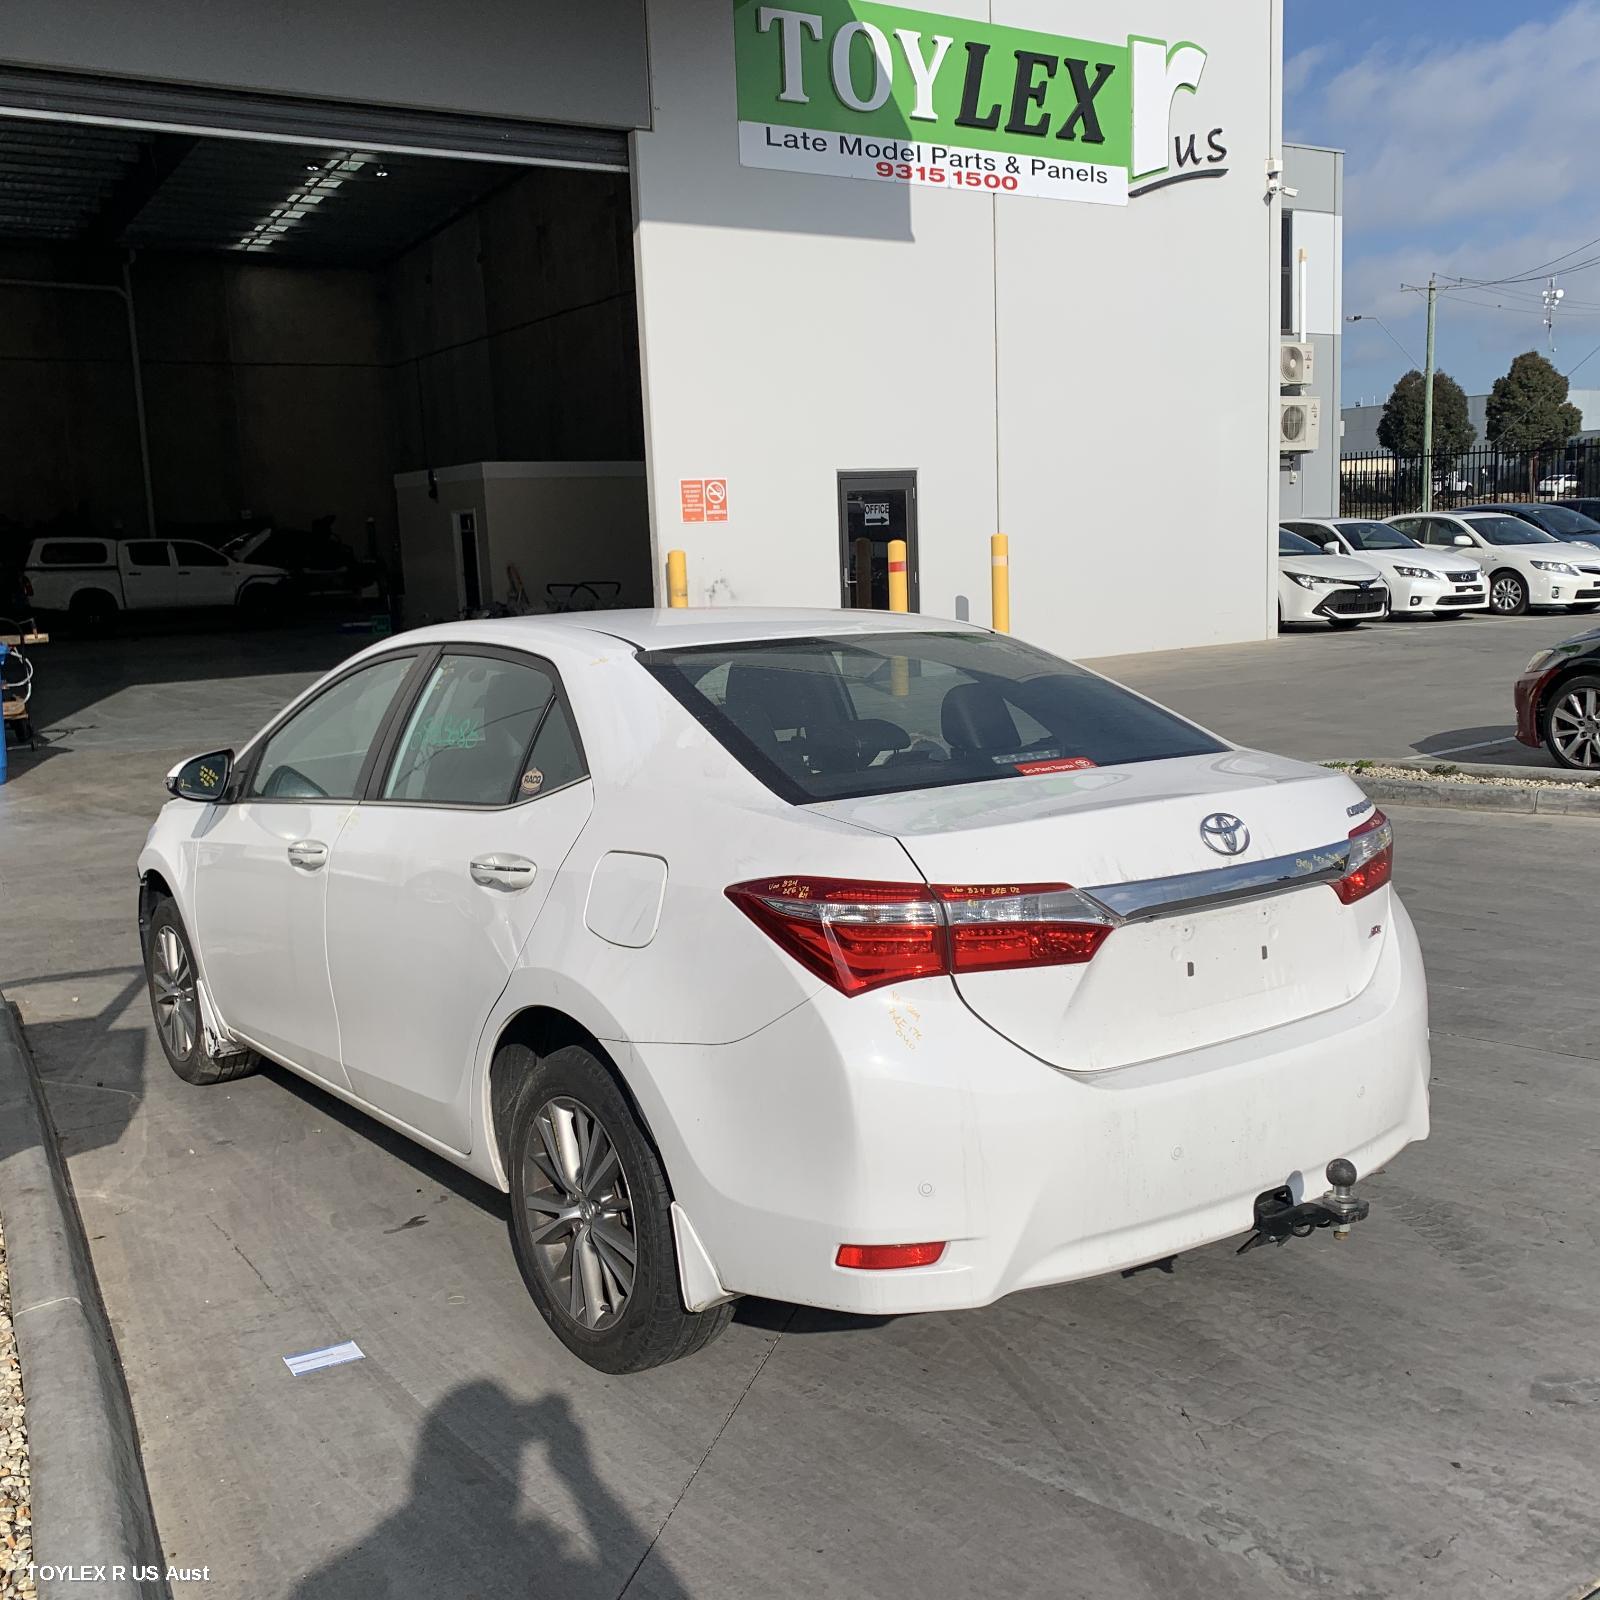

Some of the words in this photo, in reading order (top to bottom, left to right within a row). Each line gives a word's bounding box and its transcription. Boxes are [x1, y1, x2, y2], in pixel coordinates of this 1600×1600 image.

[755, 5, 1116, 144] TOYLEX
[1175, 128, 1227, 168] us
[766, 126, 828, 152] Late
[839, 135, 921, 163] Model
[932, 146, 996, 171] Parts
[1005, 155, 1021, 175] &
[1031, 158, 1108, 184] Panels
[876, 161, 946, 183] 9315
[953, 170, 1018, 191] 1500
[865, 504, 889, 514] OFFICE
